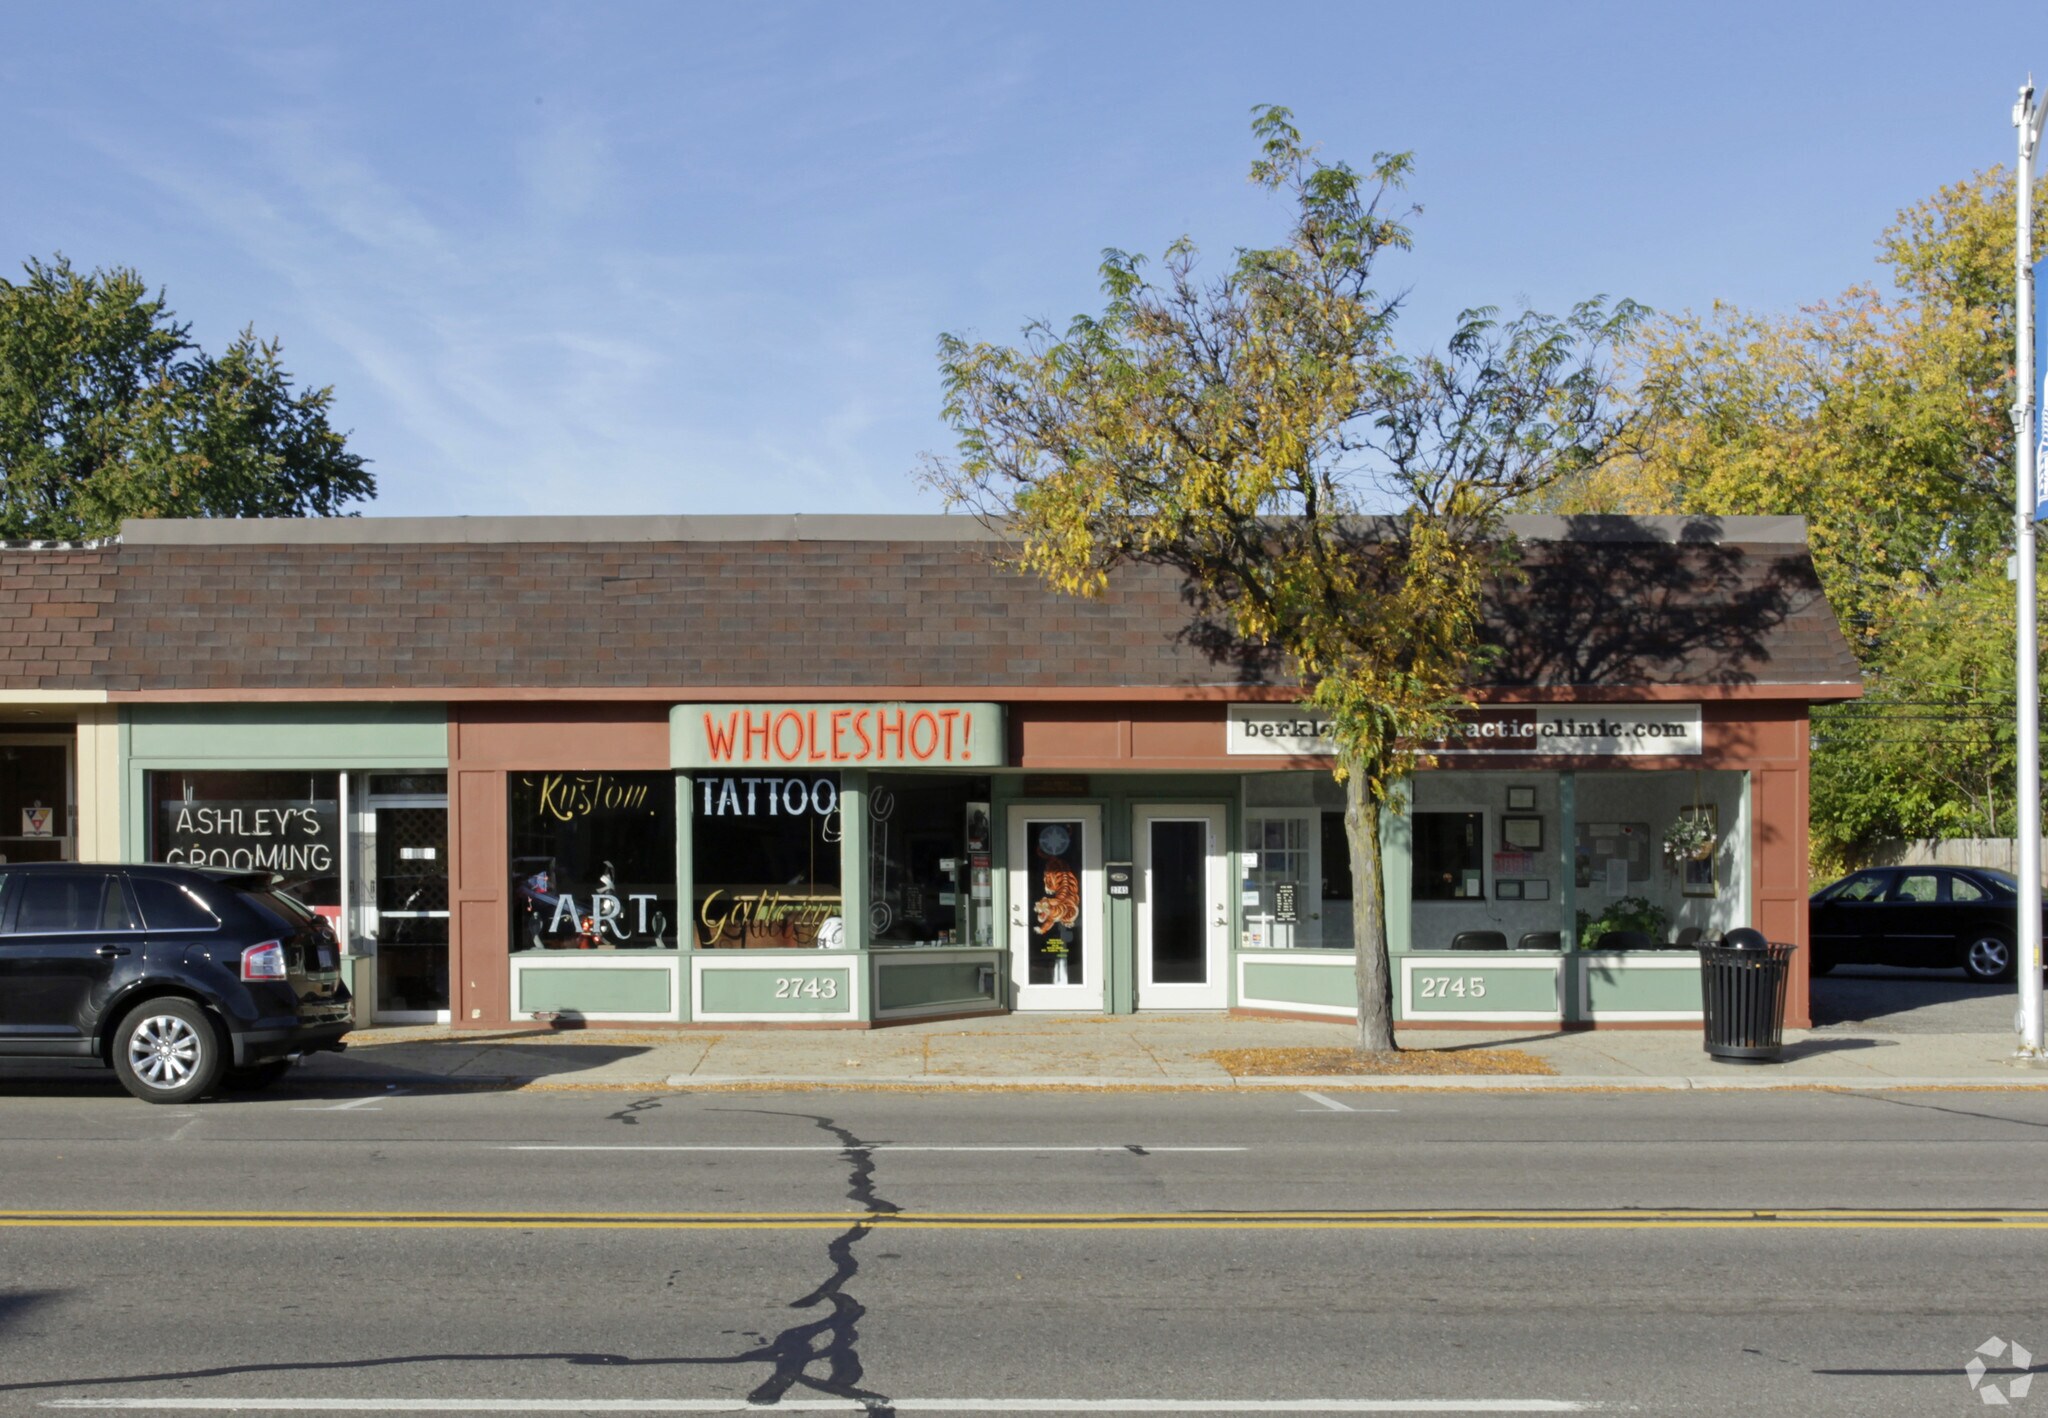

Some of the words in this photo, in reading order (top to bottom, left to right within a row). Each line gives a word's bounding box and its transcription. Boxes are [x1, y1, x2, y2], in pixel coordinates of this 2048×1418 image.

[702, 708, 973, 762] WHOLESHOT!
[1540, 718, 1687, 738] clinic.com
[697, 778, 837, 816] TATTOO
[176, 808, 322, 836] ASHLEY'S
[548, 893, 658, 939] ART
[775, 977, 838, 1000] 2743
[1421, 977, 1487, 998] 2745
